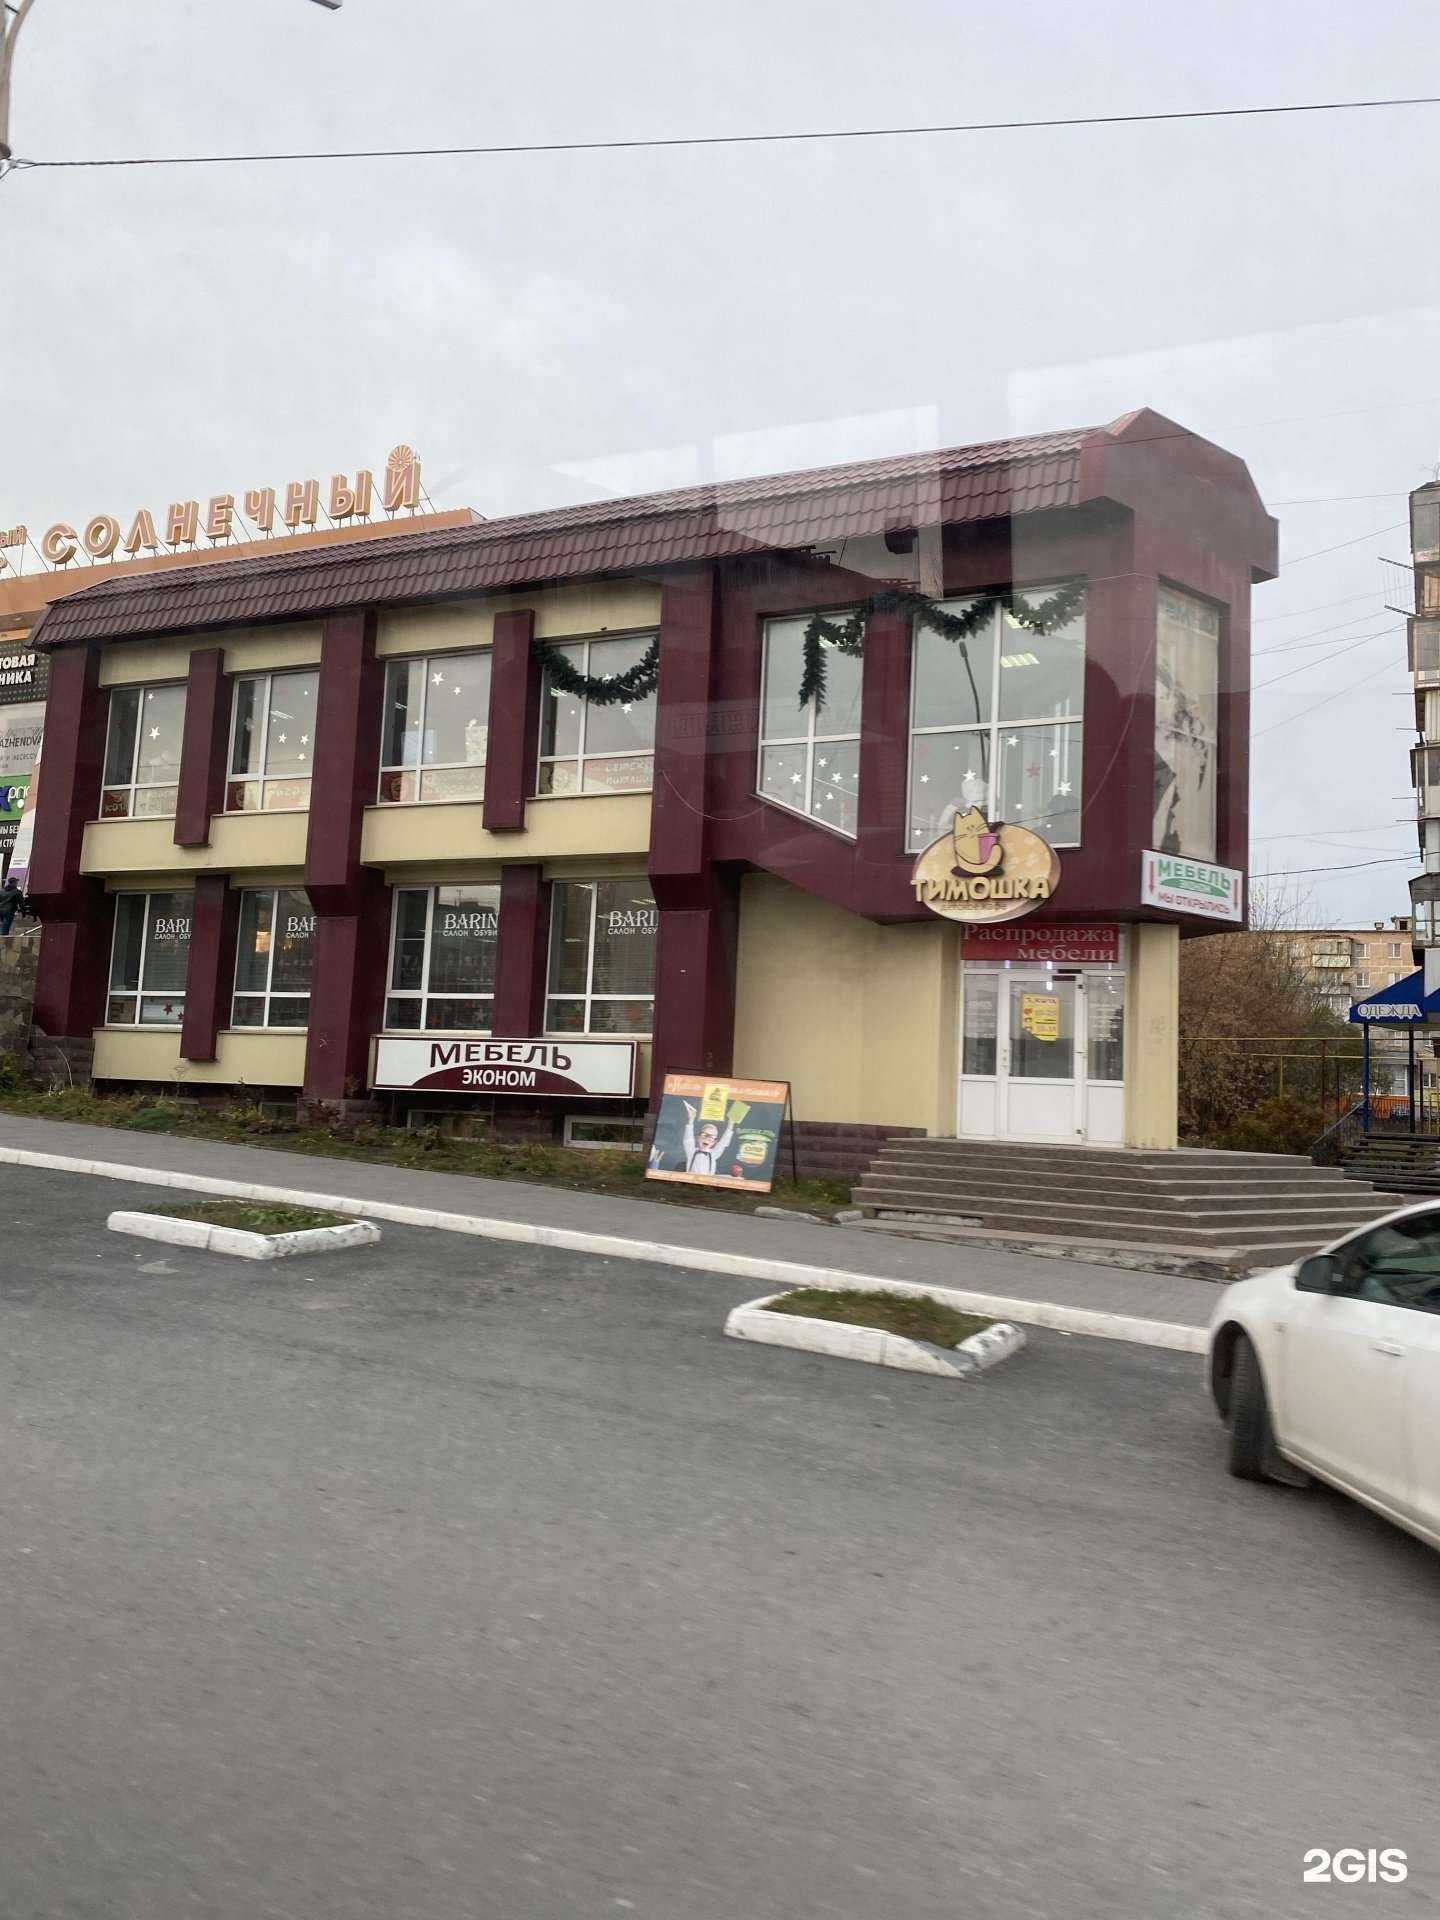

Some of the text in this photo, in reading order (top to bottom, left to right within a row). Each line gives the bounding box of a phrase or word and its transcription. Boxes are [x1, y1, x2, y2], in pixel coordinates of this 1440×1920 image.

[41, 446, 421, 565] СОЛНЕЧНЫЙ
[1158, 859, 1231, 890] МЕБЕЛЬ
[910, 876, 1050, 902] ТИМОШКА
[962, 924, 1115, 945] Распродажа
[1017, 945, 1115, 961] мебели
[1357, 1003, 1423, 1019] ОДЕЖДА
[430, 1043, 572, 1071] МЕБЕЛЬ
[461, 1068, 536, 1087] ЭКОНОМ
